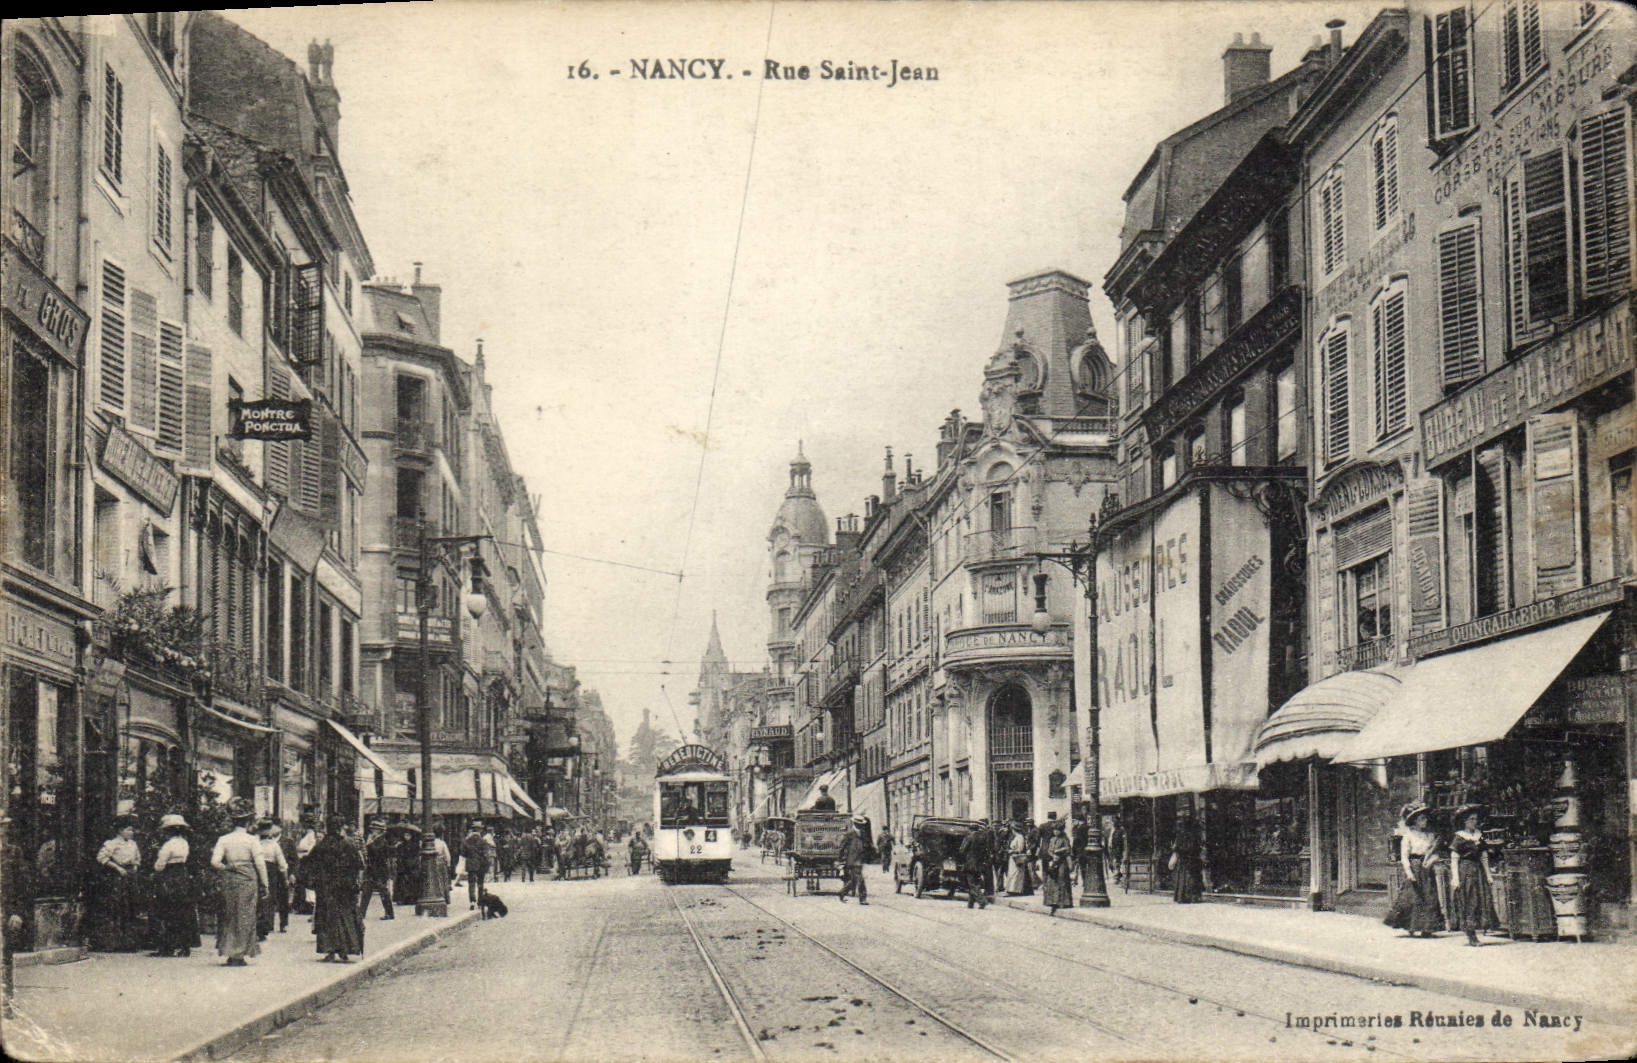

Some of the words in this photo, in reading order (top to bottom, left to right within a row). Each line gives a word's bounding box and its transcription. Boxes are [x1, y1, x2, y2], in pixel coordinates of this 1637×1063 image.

[1434, 134, 1502, 206] CORSETS
[1537, 43, 1613, 120] MESURE
[39, 291, 80, 348] GROS
[241, 407, 295, 420] MONTRE
[1425, 388, 1485, 461] BUREAU
[1492, 393, 1510, 428] DE
[1214, 554, 1265, 606] CHAUSSURES
[998, 631, 1047, 645] NANCY
[1213, 605, 1266, 655] RAOUL
[1452, 600, 1556, 644] QUINCAILLERIE
[663, 745, 725, 770] BENEDICTINE
[690, 845, 703, 855] 22
[707, 832, 716, 842] 4
